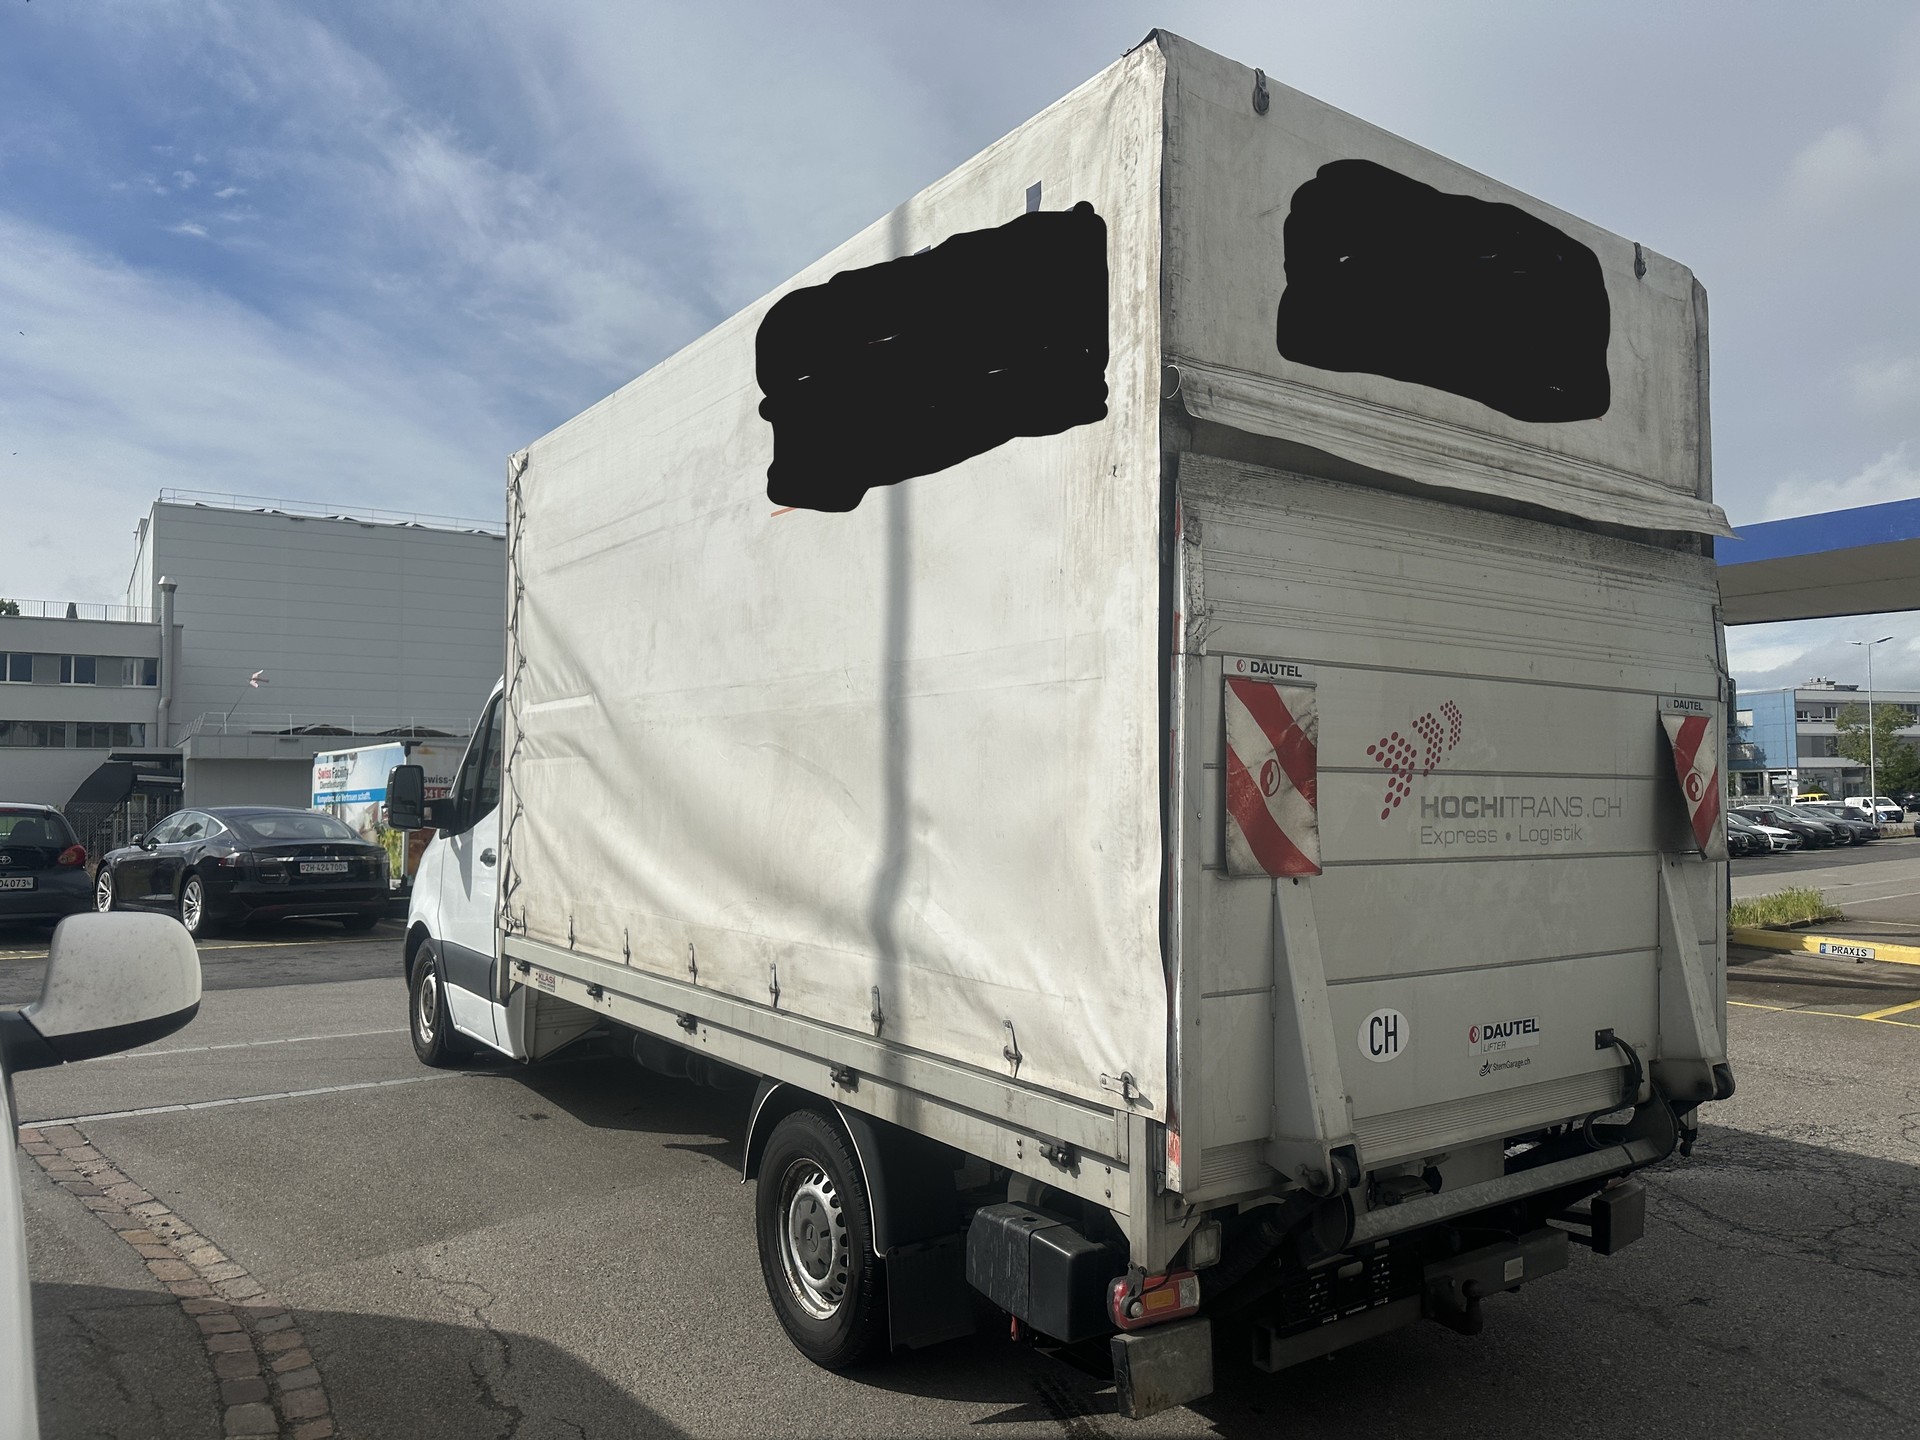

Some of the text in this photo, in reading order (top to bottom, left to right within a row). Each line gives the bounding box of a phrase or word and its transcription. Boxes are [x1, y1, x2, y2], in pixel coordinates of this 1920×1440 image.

[1250, 661, 1303, 678] DAUTEL
[1673, 699, 1704, 711] DAUTEL
[317, 767, 331, 780] Swiss
[1420, 795, 1622, 819] HOCHITRANS.CH
[1420, 823, 1583, 848] Express Logistik
[1831, 945, 1867, 957] PRAXIS
[1369, 1014, 1398, 1056] CH
[1483, 1018, 1540, 1041] DAUTEL
[1483, 1041, 1506, 1053] LIFTER
